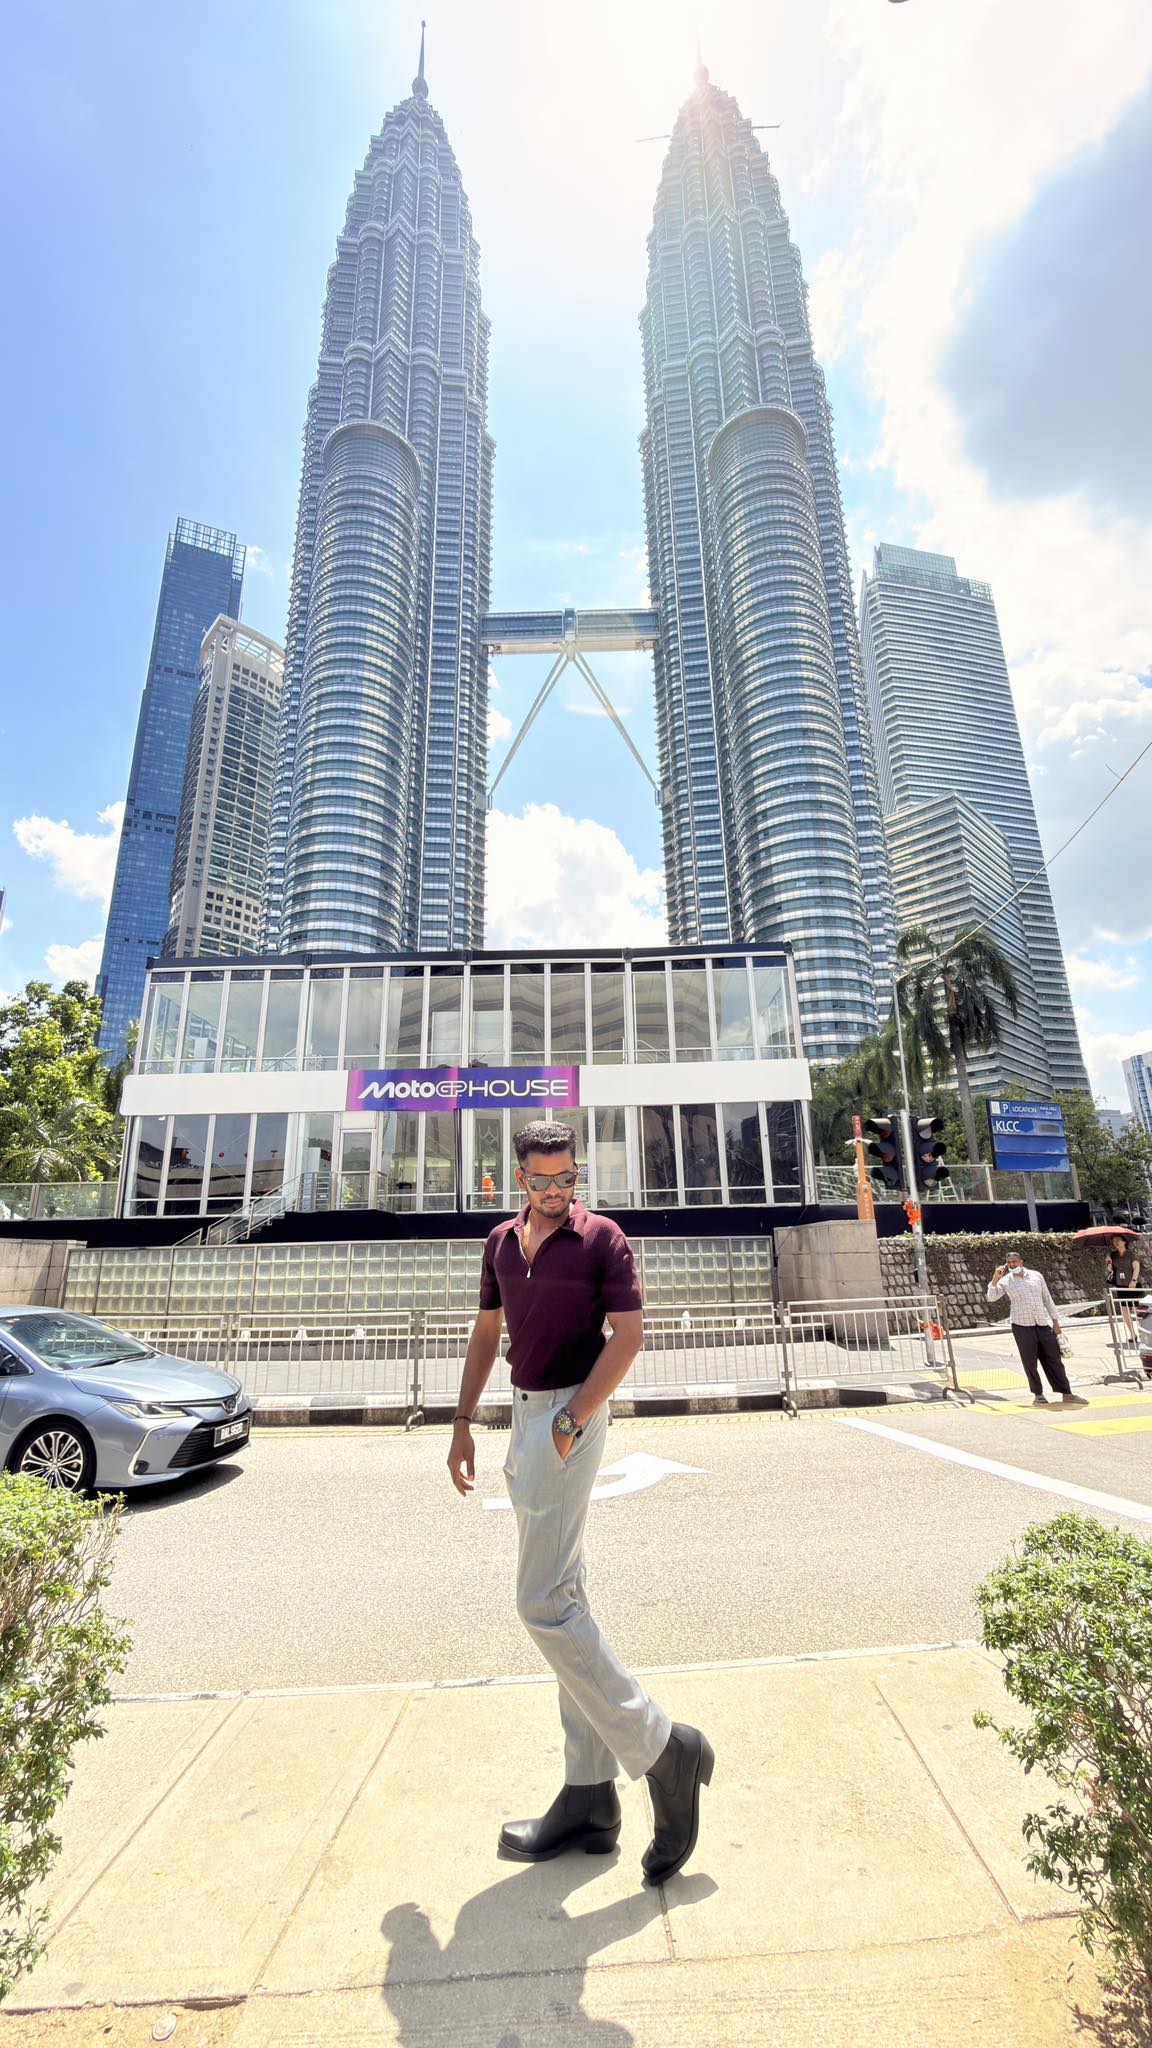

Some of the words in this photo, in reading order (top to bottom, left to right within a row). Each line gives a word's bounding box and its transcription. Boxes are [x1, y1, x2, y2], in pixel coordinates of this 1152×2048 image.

[358, 1080, 467, 1099] MotoGP
[469, 1079, 569, 1097] HOUSE
[1002, 1103, 1009, 1113] P
[995, 1120, 1021, 1132] KLCC
